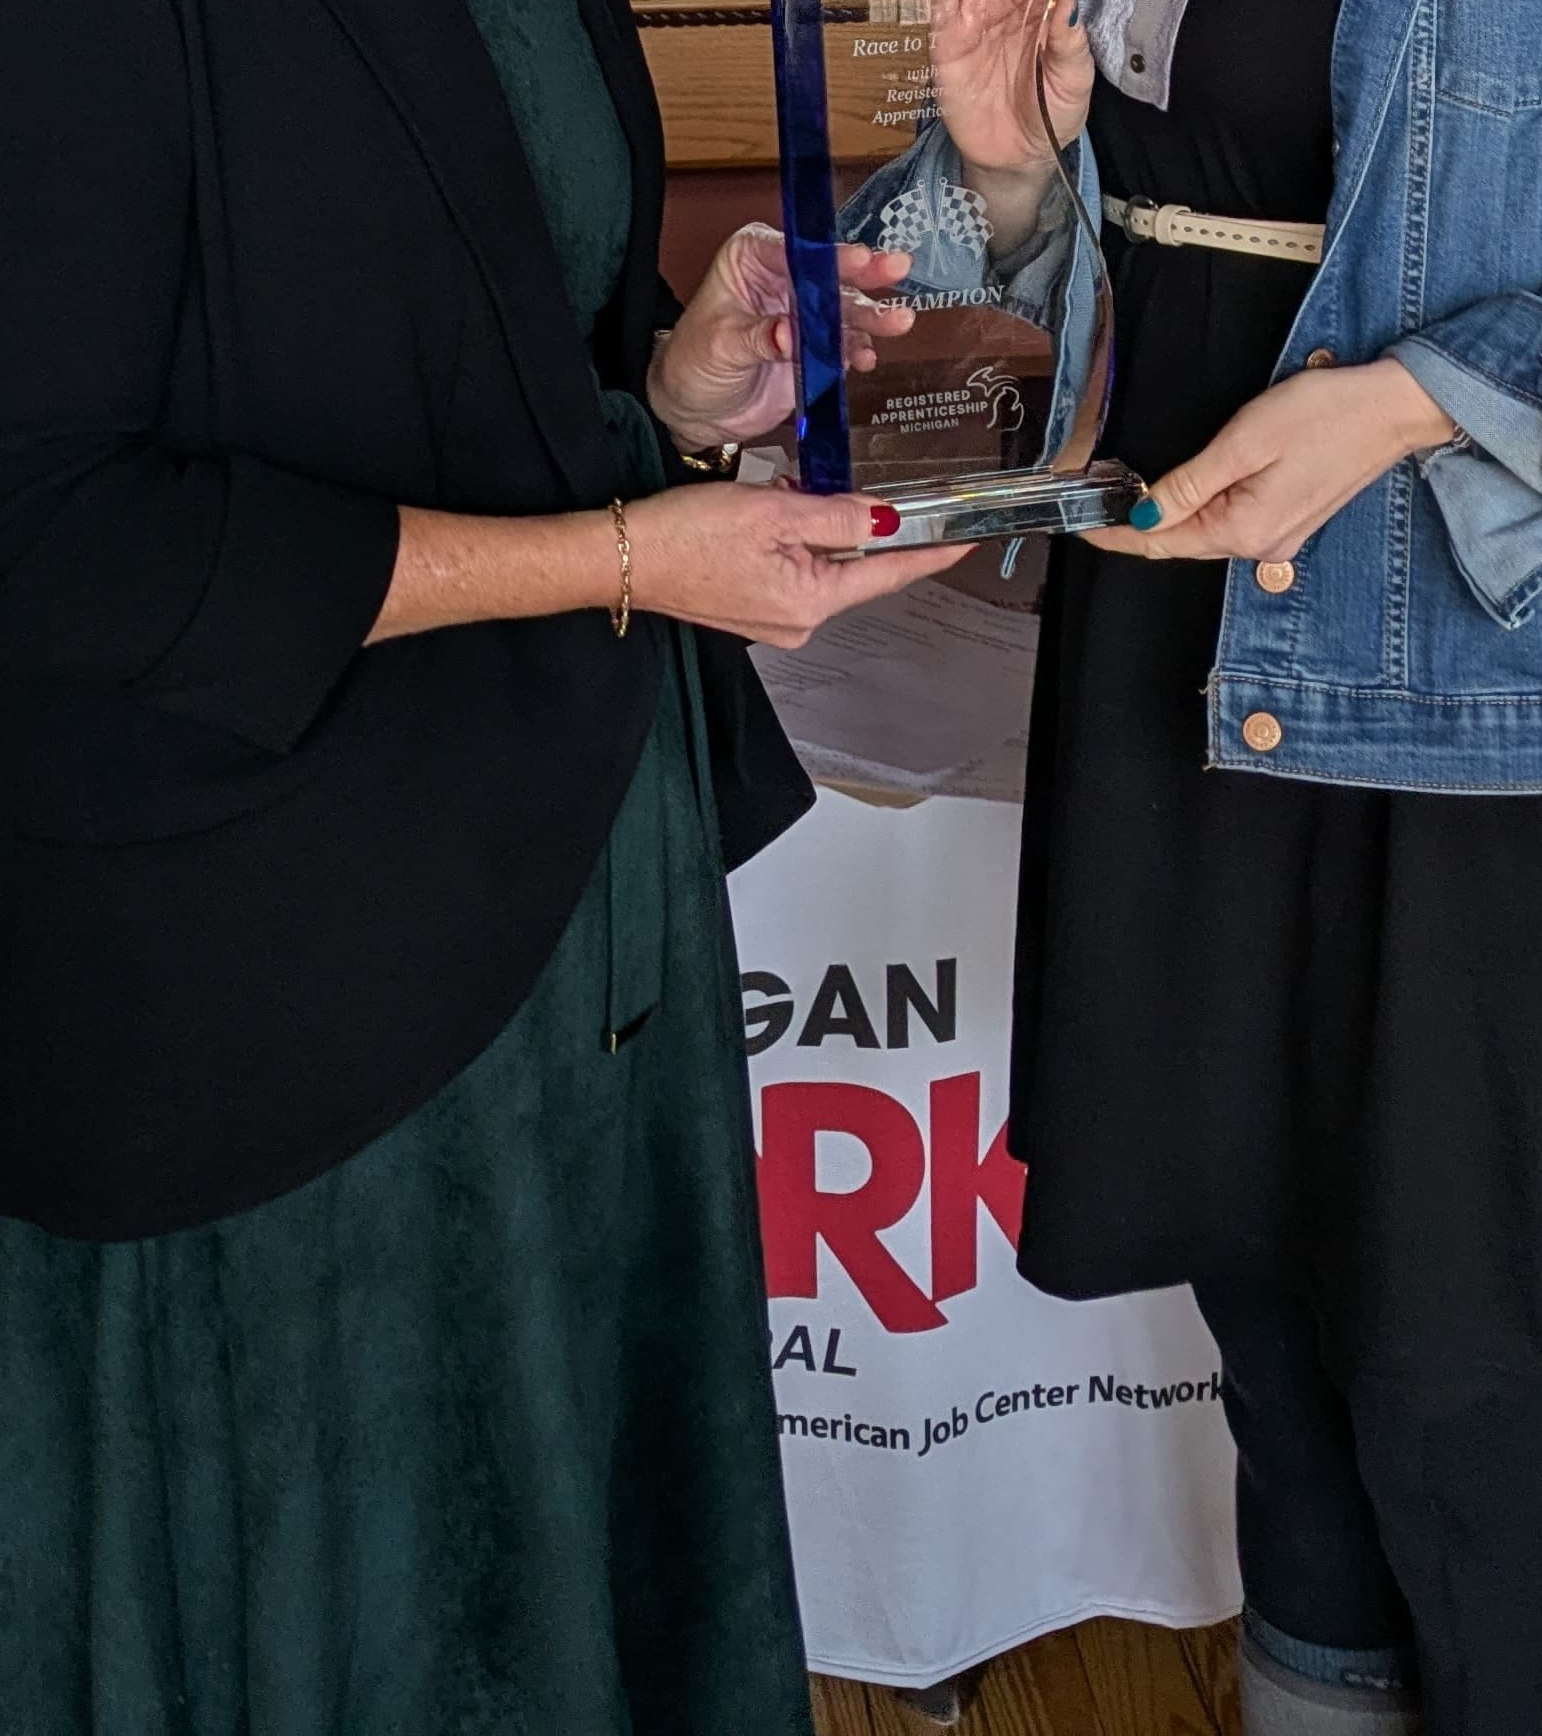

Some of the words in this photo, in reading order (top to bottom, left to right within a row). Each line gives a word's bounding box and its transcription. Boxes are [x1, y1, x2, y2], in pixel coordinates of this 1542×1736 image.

[852, 38, 899, 57] Race
[904, 36, 922, 52] to
[907, 64, 939, 81] with
[886, 85, 946, 104] Register
[872, 104, 944, 127] Apprentic
[874, 285, 1006, 316] CHAMPION
[886, 389, 971, 410] REGISTERED
[871, 401, 989, 425] APPRENTICESHIP
[900, 418, 960, 434] MICHIGAN
[778, 1412, 911, 1451] merican
[917, 1407, 969, 1456] Job
[974, 1381, 1080, 1424] Center
[1087, 1373, 1225, 1410] Network
